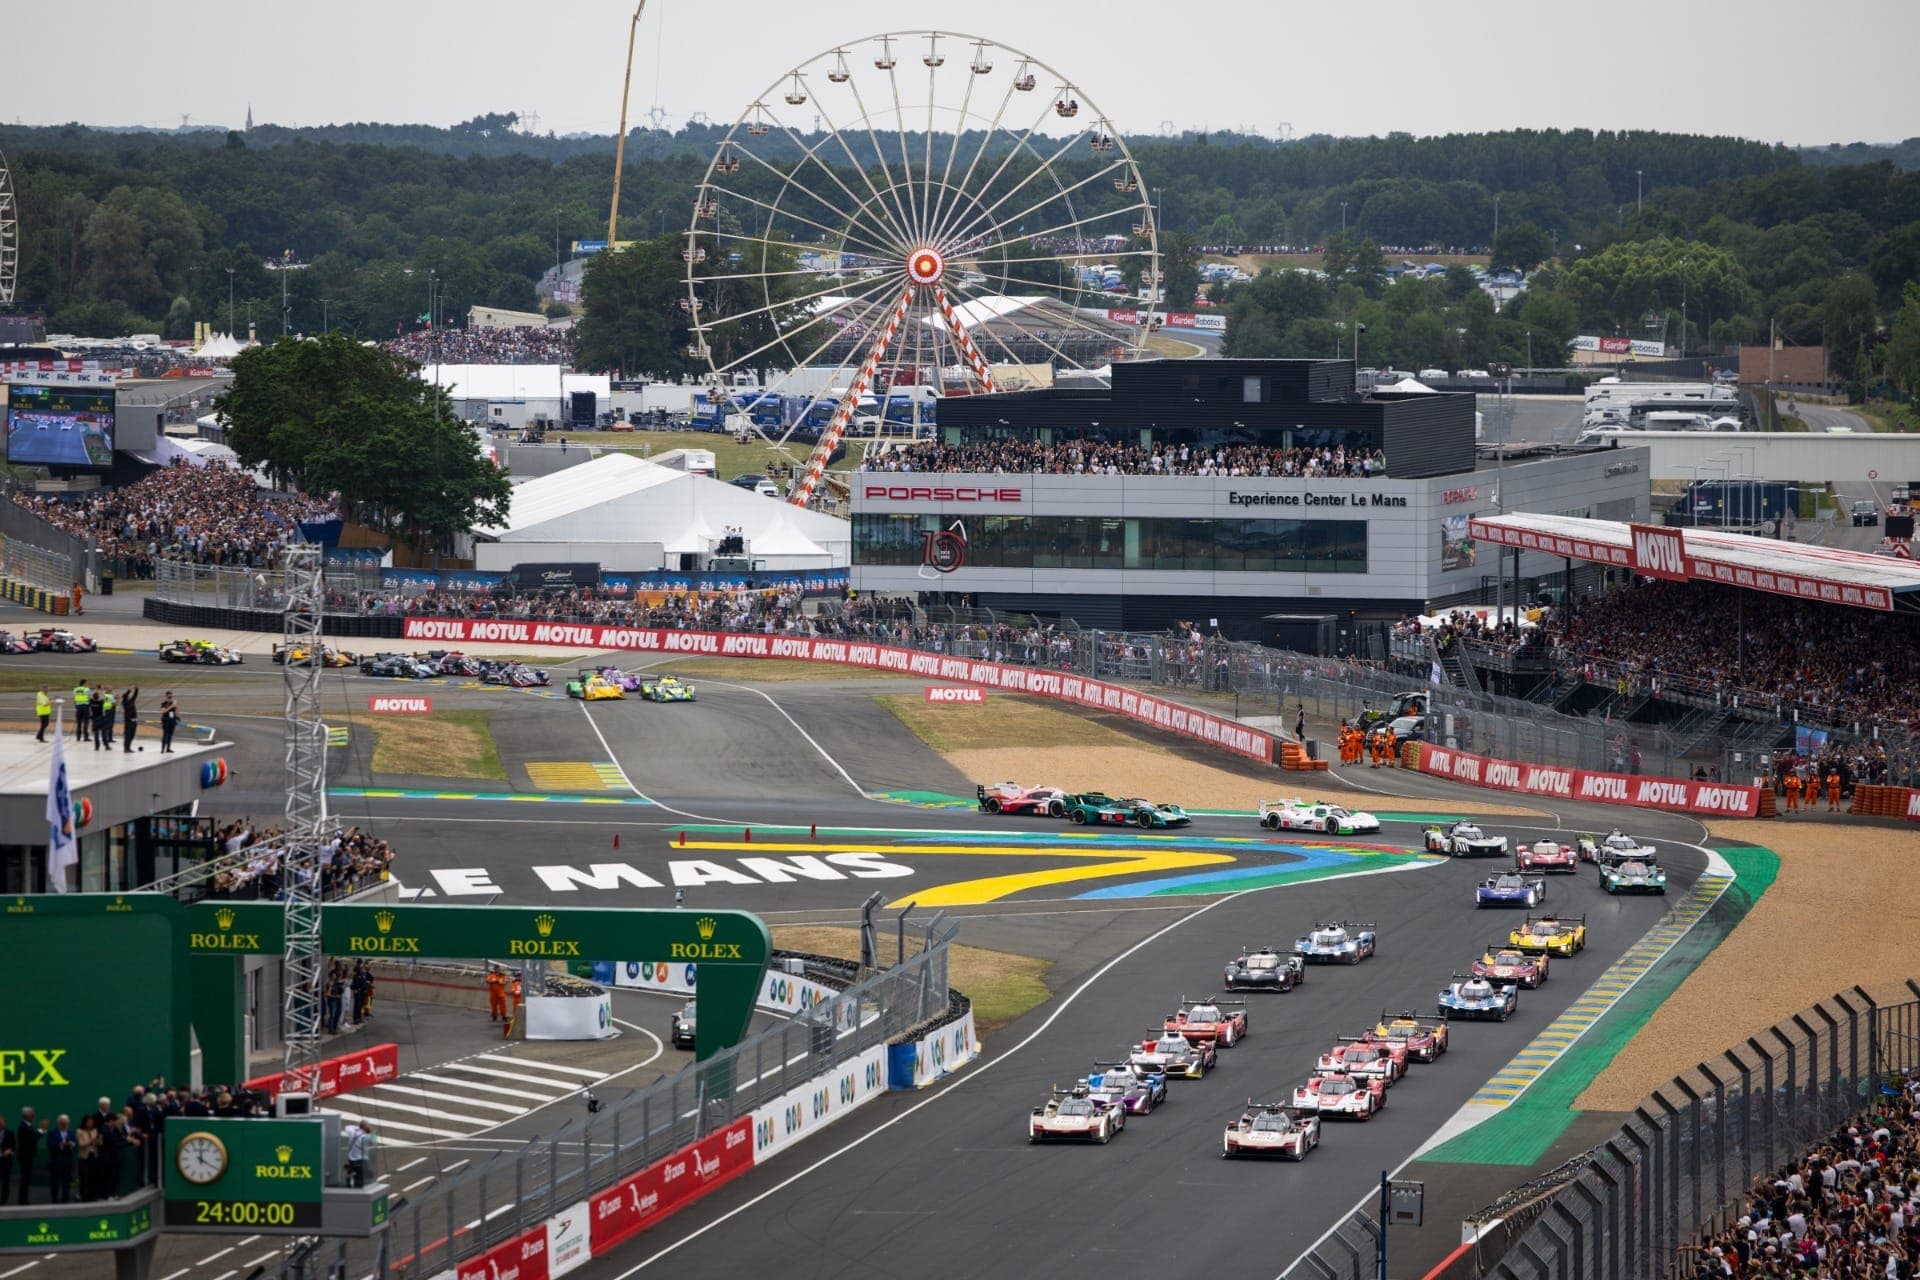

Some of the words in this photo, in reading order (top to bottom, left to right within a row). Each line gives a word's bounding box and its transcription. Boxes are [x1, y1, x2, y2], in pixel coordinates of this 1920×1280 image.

[866, 487, 1022, 502] PORSCHE
[1229, 492, 1299, 508] Experience
[1304, 492, 1346, 506] Center
[1351, 493, 1367, 506] Le
[1371, 493, 1407, 507] Mans
[1635, 531, 1684, 575] MOTUL
[407, 621, 464, 639] MOTUL
[470, 622, 529, 641] MOTUL
[533, 625, 594, 644] MOTUL
[599, 629, 659, 649] MOTUL
[664, 633, 718, 652] MOTUL
[722, 636, 768, 655] MOTUL
[771, 639, 810, 658] MOTUL
[813, 642, 846, 662] MOTUL
[849, 645, 877, 665] MOTUL
[879, 649, 908, 670] MOTUL
[910, 654, 939, 676] MOTUL
[941, 659, 969, 681] MOTUL
[971, 664, 999, 686] MOTUL
[1001, 669, 1025, 690] MOTUL
[1026, 673, 1060, 694] MOTUL
[930, 689, 982, 701] MOTUL
[374, 698, 428, 713] MOTUL
[1454, 755, 1480, 781] MOTUL
[1485, 763, 1520, 788] MOTUL
[1527, 768, 1571, 795] MOTUL
[1582, 776, 1628, 801] MOTUL
[1637, 781, 1687, 806] MOTUL
[1695, 787, 1748, 812] MOTUL
[532, 852, 916, 892] MANS
[190, 933, 260, 950] ROLEX
[350, 936, 420, 953] ROLEX
[510, 939, 581, 956] ROLEX
[671, 943, 742, 959] ROLEX
[256, 1165, 312, 1179] ROLEX
[197, 1202, 295, 1224] 24:00:00
